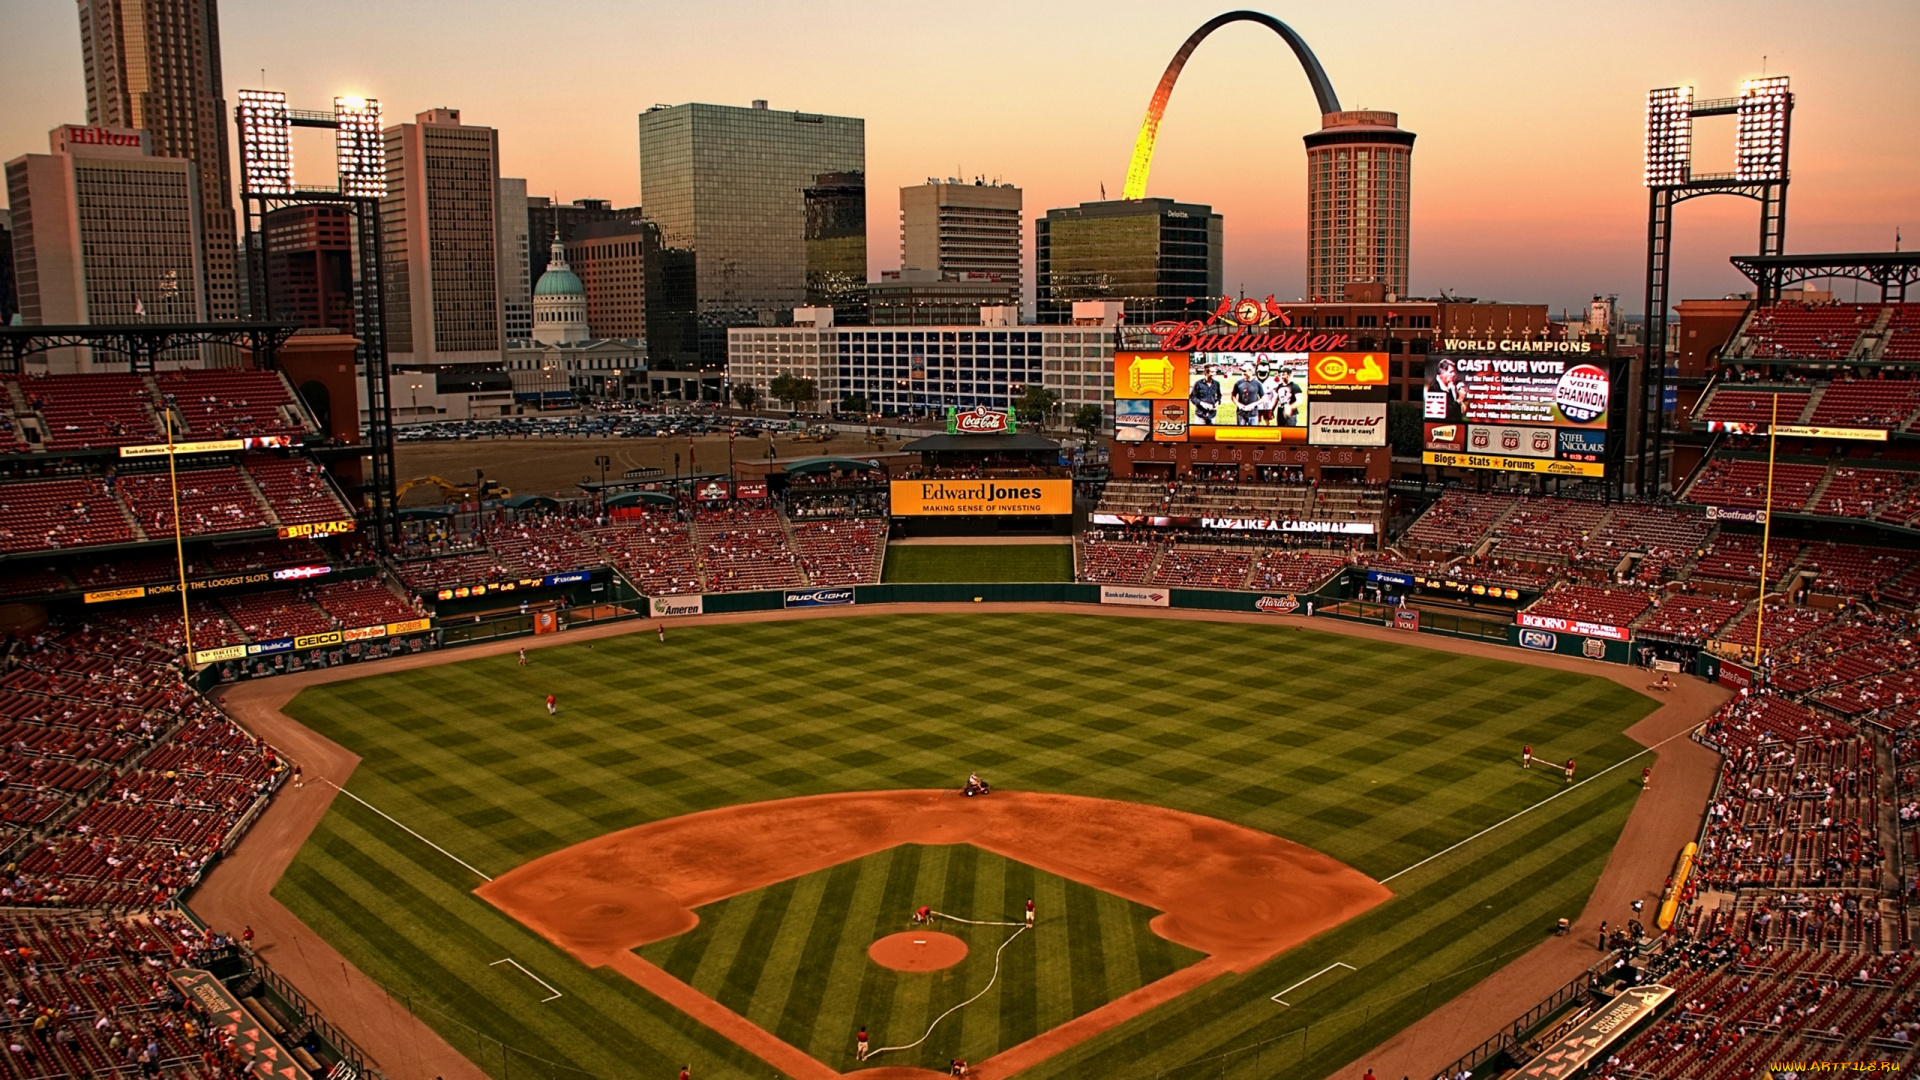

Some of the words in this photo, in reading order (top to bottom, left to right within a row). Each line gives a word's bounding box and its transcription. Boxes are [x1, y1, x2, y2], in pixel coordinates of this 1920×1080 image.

[69, 127, 140, 146] Hilton
[1150, 320, 1348, 352] Budweiser
[1444, 339, 1496, 350] WORLD
[1500, 340, 1591, 352] CHAMPIONS
[1457, 359, 1491, 372] CAST
[1492, 360, 1528, 372] YOUR
[1530, 361, 1564, 374] VOTE
[1570, 380, 1598, 390] VOTE
[1558, 386, 1606, 408] SHANNON
[1566, 407, 1590, 420] 08
[962, 414, 1001, 428] Coca-Cola
[1312, 416, 1384, 426] Schnucks
[1535, 440, 1547, 448] 66
[1560, 432, 1584, 442] STIFEL
[1562, 442, 1604, 452] NICOLAUS
[1150, 448, 1154, 458] 1
[1169, 449, 1176, 458] 2
[1190, 449, 1197, 459] 6
[1212, 449, 1218, 460] 9
[1231, 450, 1242, 460] 14
[1252, 450, 1263, 460] 17
[1273, 450, 1286, 461] 20
[1295, 451, 1308, 462] 42
[1316, 451, 1330, 462] 45
[1339, 451, 1352, 462] 85
[1434, 454, 1456, 466] Blogs
[1468, 456, 1490, 466] Stats
[1503, 459, 1535, 469] Forums
[921, 484, 986, 500] Edward
[987, 484, 1041, 501] Jones
[1718, 509, 1755, 520] Scottrade
[287, 524, 312, 538] BIG
[314, 521, 348, 532] MAC
[1202, 518, 1233, 528] PLAY
[1268, 520, 1277, 530] A
[1282, 521, 1347, 532] CARDINAL
[148, 585, 175, 594] HOME
[208, 577, 243, 588] LOOSEST
[246, 574, 269, 583] SLOTS
[787, 594, 811, 602] BUD
[817, 592, 851, 600] LIGHT
[665, 605, 698, 615] Ameren
[396, 621, 422, 629] DOBBS
[262, 642, 292, 650] HealthCare
[298, 634, 339, 646] GEICO
[1524, 632, 1551, 647] FSN
[311, 649, 320, 659] 14
[329, 651, 338, 661] 17
[1719, 668, 1733, 680] State
[1733, 673, 1748, 686] Farm
[193, 987, 221, 1013] CHAMPIONS
[1590, 1015, 1612, 1030] WORLD
[1610, 1002, 1629, 1016] SERIES
[1599, 1005, 1639, 1034] CHAMPIONS
